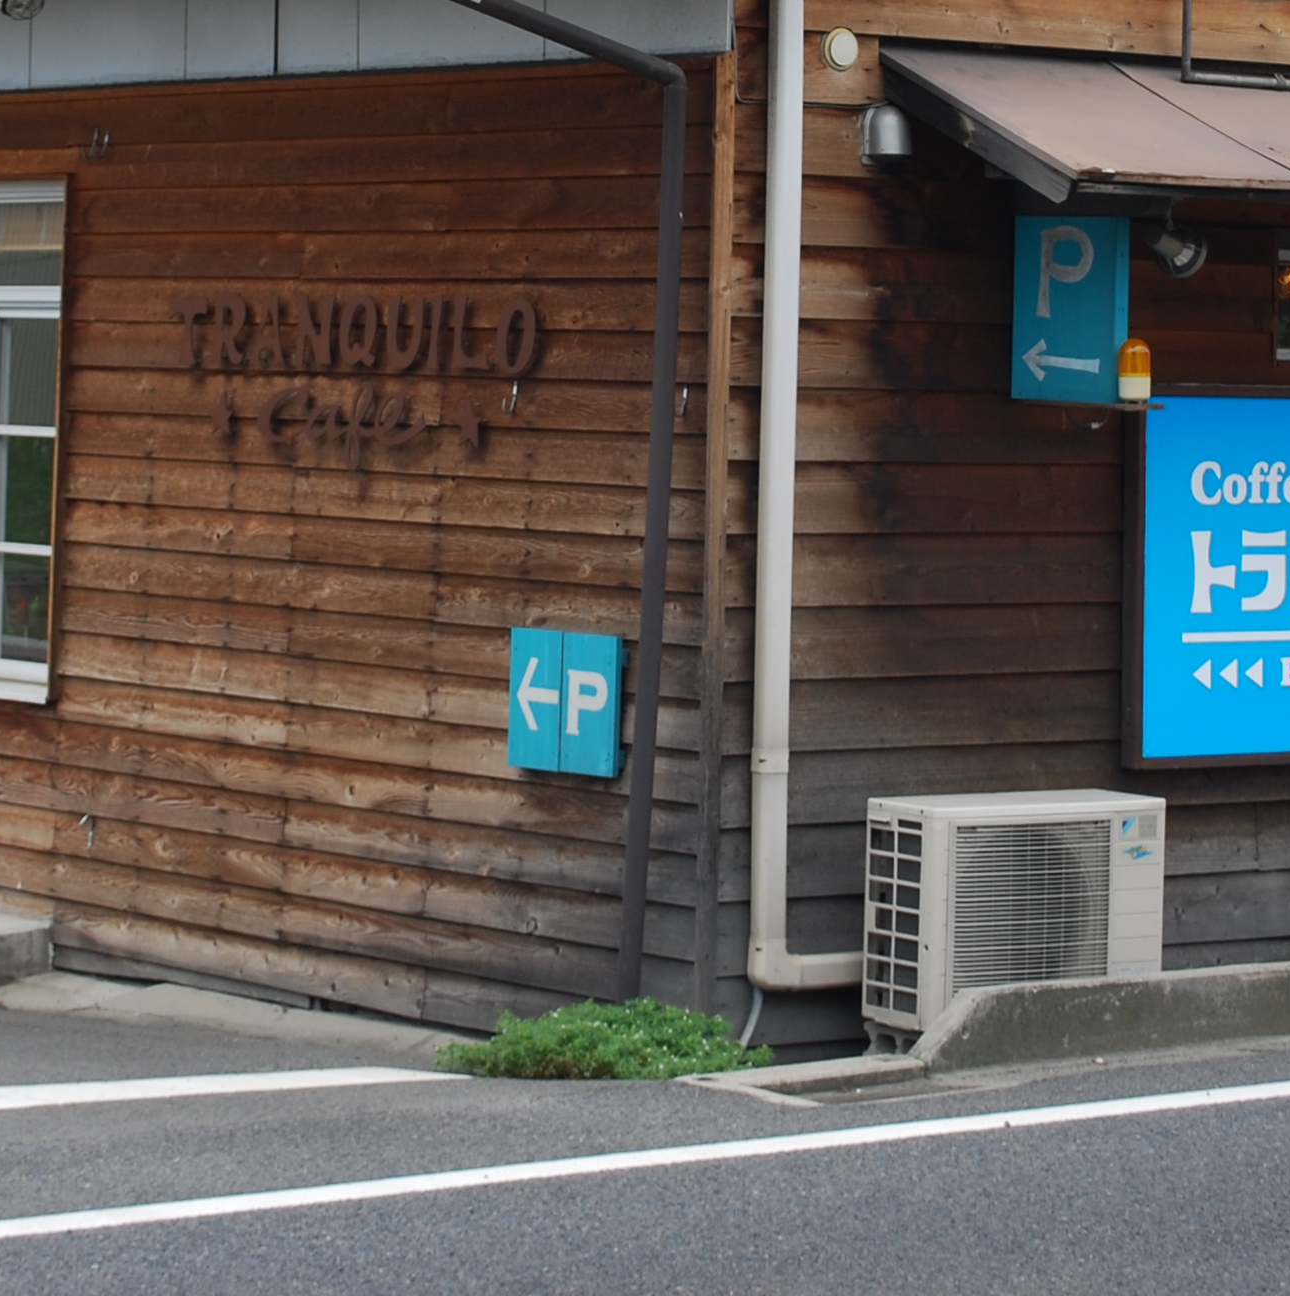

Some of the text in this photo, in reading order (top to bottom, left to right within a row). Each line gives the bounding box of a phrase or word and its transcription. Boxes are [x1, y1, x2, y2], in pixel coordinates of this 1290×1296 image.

[1035, 225, 1095, 319] P
[171, 292, 538, 375] TRANQUILO
[256, 380, 428, 471] Cafe
[566, 668, 608, 736] P
